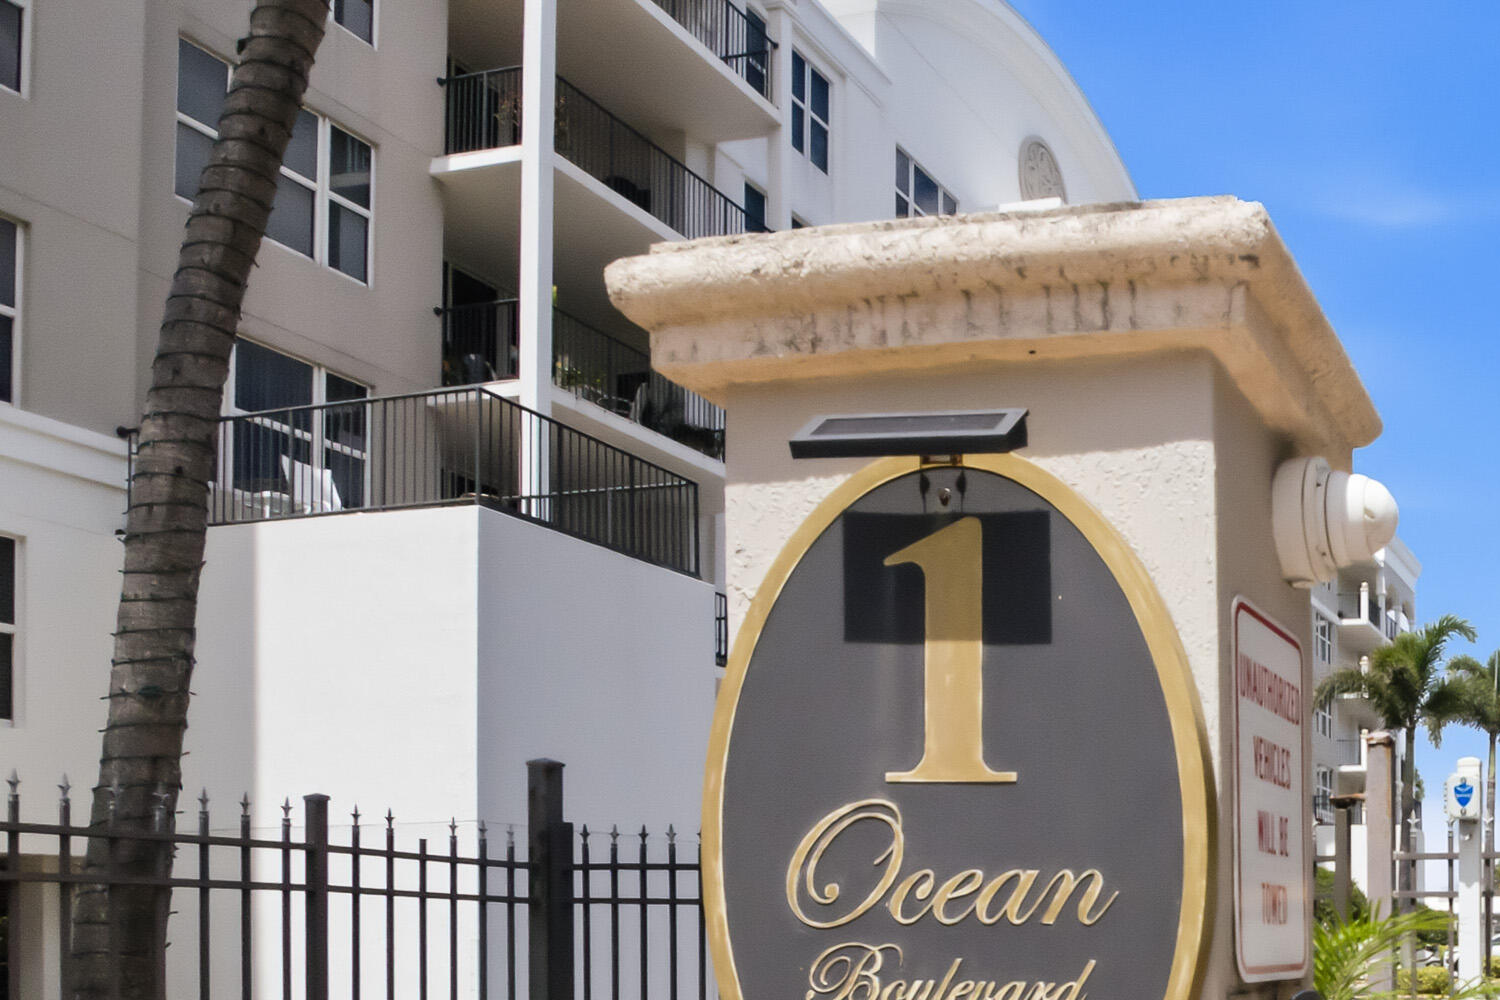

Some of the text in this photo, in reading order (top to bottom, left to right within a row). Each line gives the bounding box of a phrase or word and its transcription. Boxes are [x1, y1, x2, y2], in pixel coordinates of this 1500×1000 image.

[882, 516, 1018, 783] 1
[1239, 652, 1300, 726] UNAUTHORIZED
[1253, 735, 1291, 790] VEHICLES
[785, 797, 1119, 930] Ocean
[1257, 810, 1289, 858] WILL BE
[1261, 882, 1288, 926] TOWED
